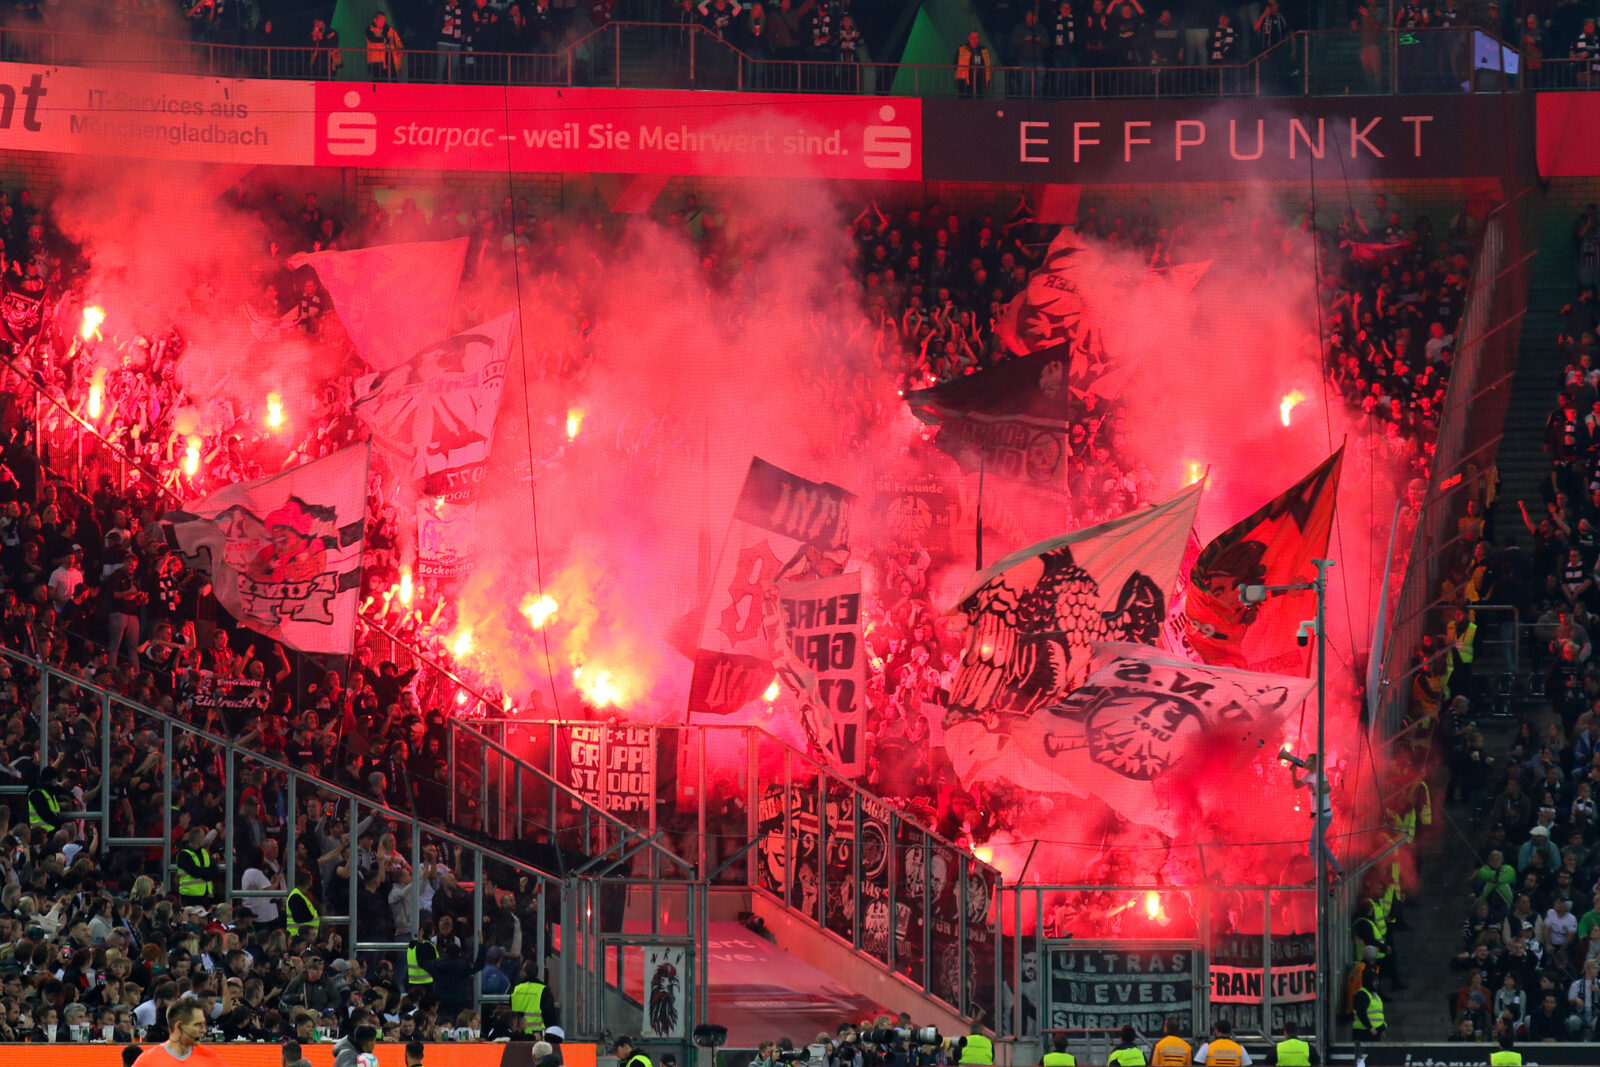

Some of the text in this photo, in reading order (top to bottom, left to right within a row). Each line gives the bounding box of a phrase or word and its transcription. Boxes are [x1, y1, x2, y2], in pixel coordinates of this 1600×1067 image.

[88, 88, 248, 119] IT-Services aus
[69, 114, 269, 146] Mönchengladbach
[392, 121, 495, 152] starpac
[523, 122, 580, 149] weil
[588, 123, 630, 150] Sie
[639, 125, 776, 152] Mehrwert
[783, 127, 849, 156] sind.
[1059, 953, 1186, 973] ULTRAS
[1070, 982, 1178, 1005] NEVER
